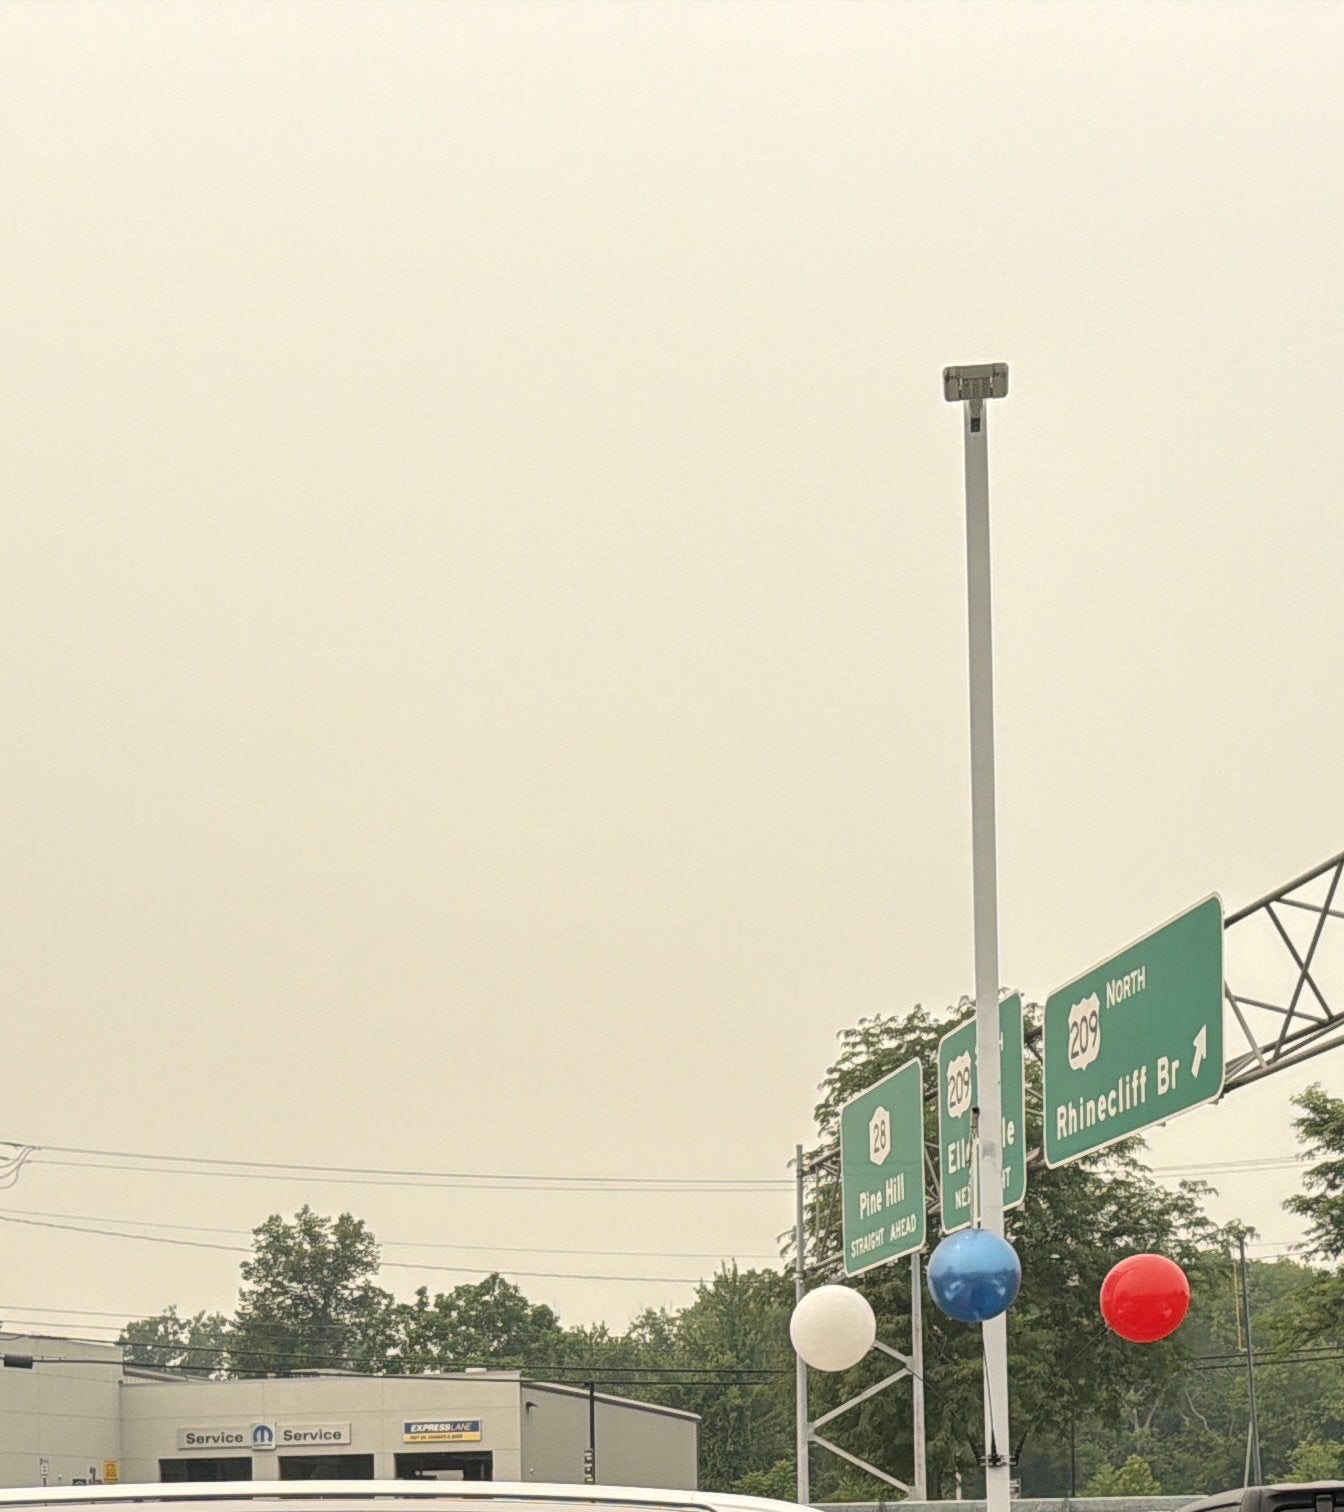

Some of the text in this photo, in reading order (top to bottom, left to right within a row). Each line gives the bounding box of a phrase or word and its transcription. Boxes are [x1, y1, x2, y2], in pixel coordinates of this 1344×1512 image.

[1107, 966, 1146, 1009] NORTH
[1070, 1010, 1098, 1060] 209
[949, 1066, 970, 1106] 209
[1057, 1056, 1180, 1141] Rhinecliff Br
[873, 1119, 886, 1153] 28
[859, 1172, 905, 1220] Pine Hill
[851, 1214, 917, 1258] STRAIGHT AHEAD
[186, 1429, 342, 1444] Service Service
